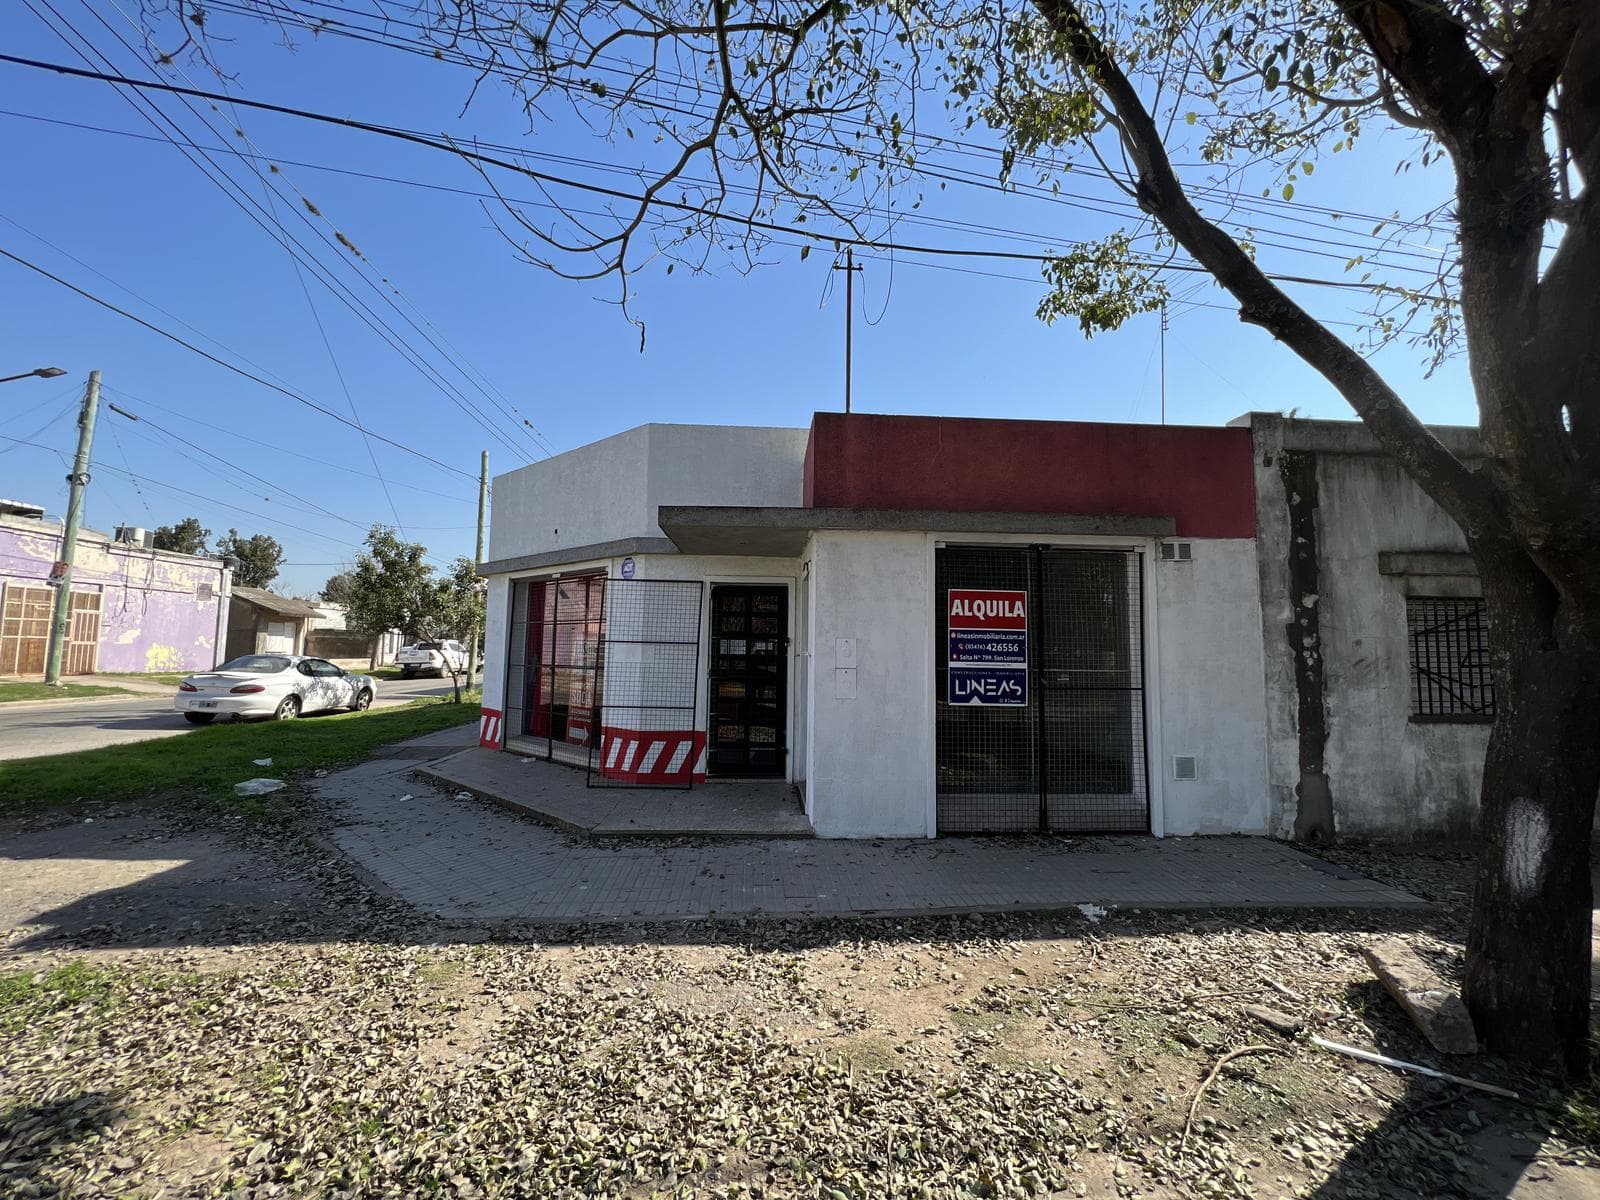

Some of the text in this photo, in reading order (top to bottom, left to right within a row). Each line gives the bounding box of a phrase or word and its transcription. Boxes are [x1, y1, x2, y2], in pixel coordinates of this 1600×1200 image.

[951, 599, 1025, 620] ALQUILA
[986, 643, 1019, 652] 426556
[955, 679, 1022, 696] LINEAS
